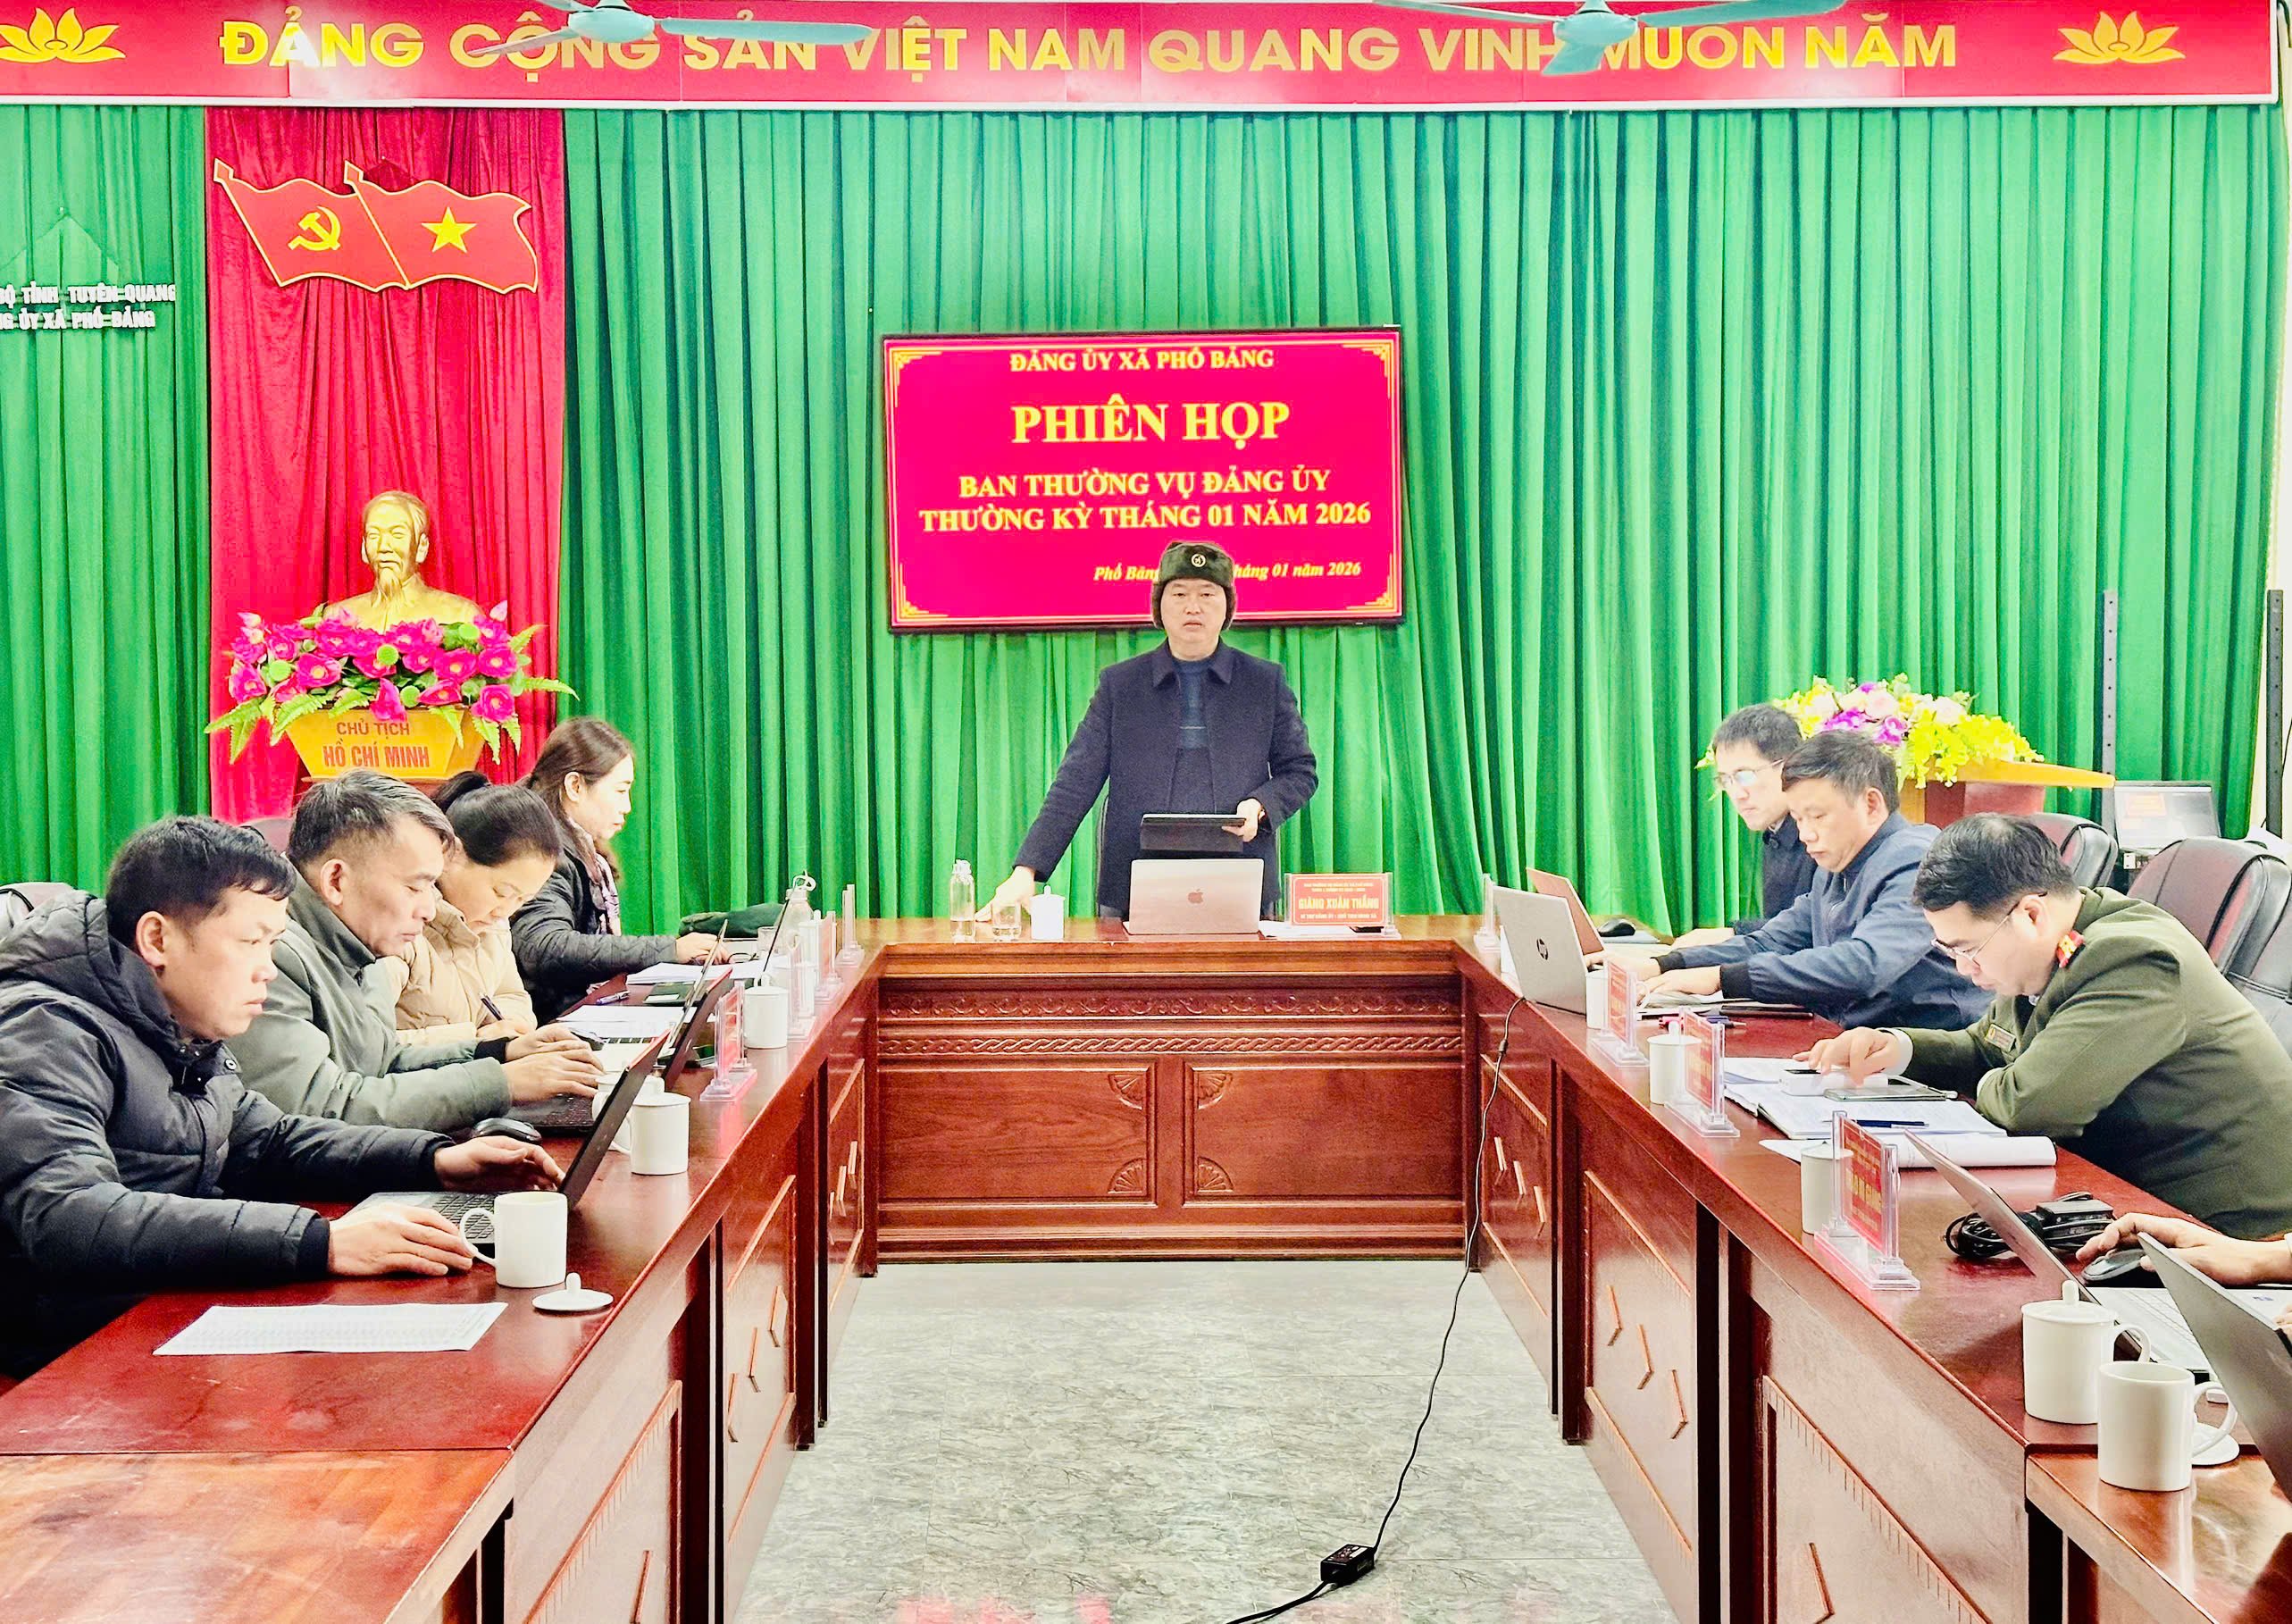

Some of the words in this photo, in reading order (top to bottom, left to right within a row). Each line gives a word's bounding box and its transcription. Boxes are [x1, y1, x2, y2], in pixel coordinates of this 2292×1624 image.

[219, 5, 424, 68] ĐẢNG
[449, 11, 661, 82] CỘNG
[682, 10, 816, 71] SẢN
[843, 16, 967, 82] VIỆT
[988, 29, 1125, 71] NAM
[1149, 29, 1400, 71] QUANG
[1421, 28, 1568, 71] VINH
[1804, 13, 1957, 69] NĂM
[68, 282, 118, 304] TUYÊN
[124, 284, 176, 303] QUANG
[112, 305, 156, 328] BẢNG
[1010, 349, 1076, 372] ĐẢNG
[1082, 347, 1114, 371] ỦY
[1118, 347, 1150, 370] XÃ
[1157, 346, 1205, 369] PHỐ
[1210, 345, 1275, 368] BẢNG
[1011, 393, 1168, 443] PHIÊN
[1182, 401, 1290, 450] HỌP
[958, 475, 1016, 498] BAN
[1024, 467, 1150, 497] THƯỜNG
[1155, 472, 1196, 499] VỤ
[1202, 465, 1284, 493] ĐẢNG
[1292, 464, 1331, 492] ỦY
[919, 503, 1044, 532] THƯỜNG
[1051, 501, 1093, 530] KỲ
[1100, 499, 1200, 529] THÁNG
[1208, 504, 1234, 527] 01
[1242, 498, 1308, 526] NĂM
[1315, 501, 1372, 524] 2026
[1094, 563, 1123, 581] Phố
[1230, 562, 1268, 581] háng
[1272, 563, 1288, 577] 01
[1292, 563, 1324, 577] năm
[1327, 561, 1361, 576] 2026
[337, 718, 370, 736] CHỦ
[374, 722, 410, 740] TỊCH
[322, 738, 348, 768] HỒ
[351, 741, 380, 767] CHÍ
[384, 746, 431, 768] MINH
